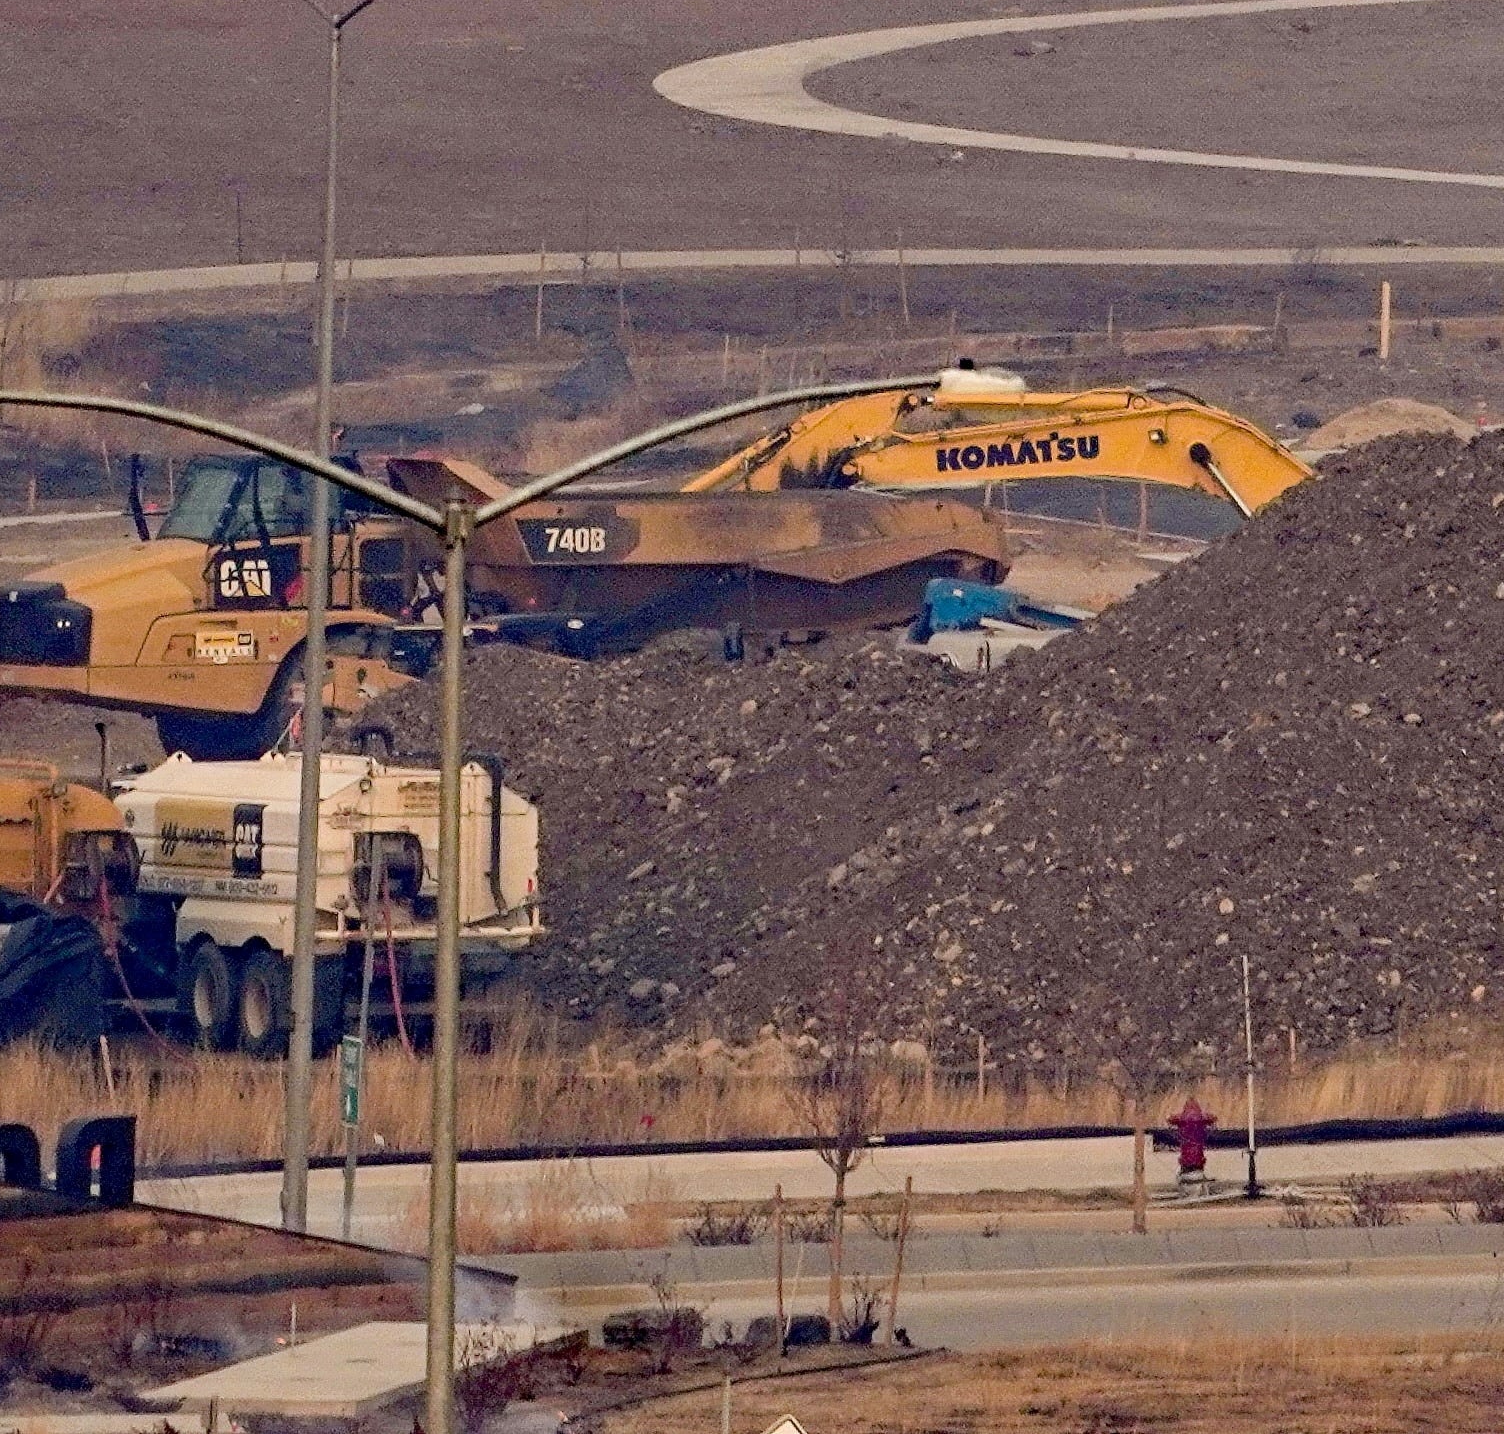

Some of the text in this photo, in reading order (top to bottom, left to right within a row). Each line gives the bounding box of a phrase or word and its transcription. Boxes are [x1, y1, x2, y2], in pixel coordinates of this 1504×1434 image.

[936, 432, 1100, 472] KOMATSU
[546, 527, 605, 553] 740B
[219, 559, 271, 597] CAT
